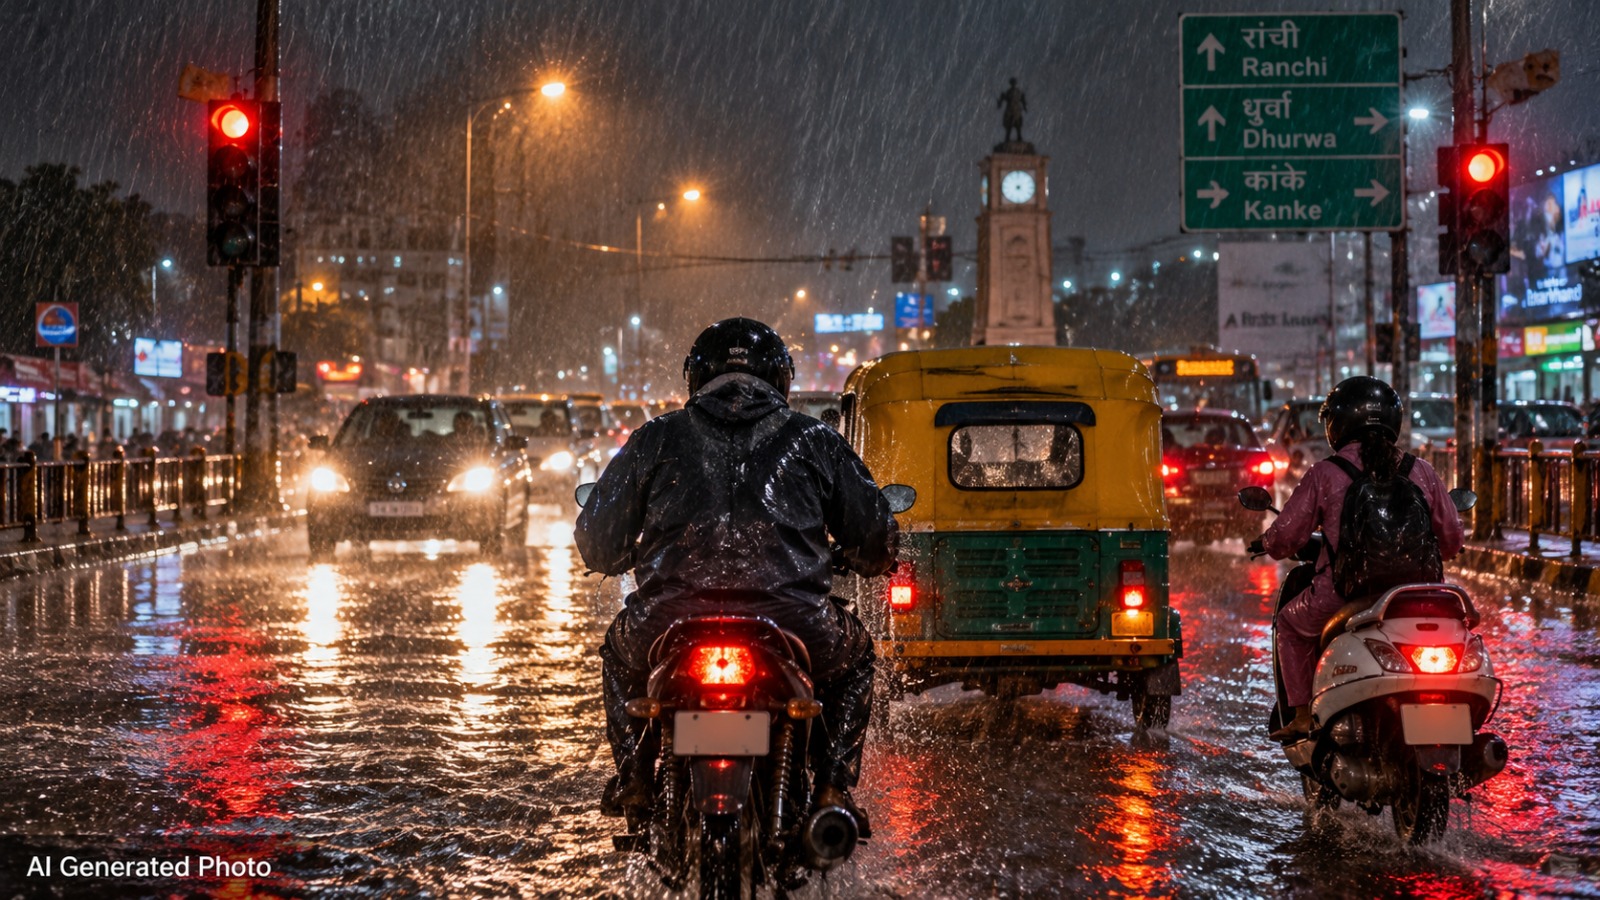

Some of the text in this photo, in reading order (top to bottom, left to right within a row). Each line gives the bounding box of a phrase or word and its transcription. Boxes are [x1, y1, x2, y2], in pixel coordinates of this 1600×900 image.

[1241, 20, 1300, 49] रांची
[1243, 57, 1327, 77] Ranchi
[1242, 91, 1292, 125] धुर्वा
[1244, 129, 1336, 148] Dhurwa
[1243, 162, 1307, 191] कांके
[1244, 200, 1322, 220] Kanke
